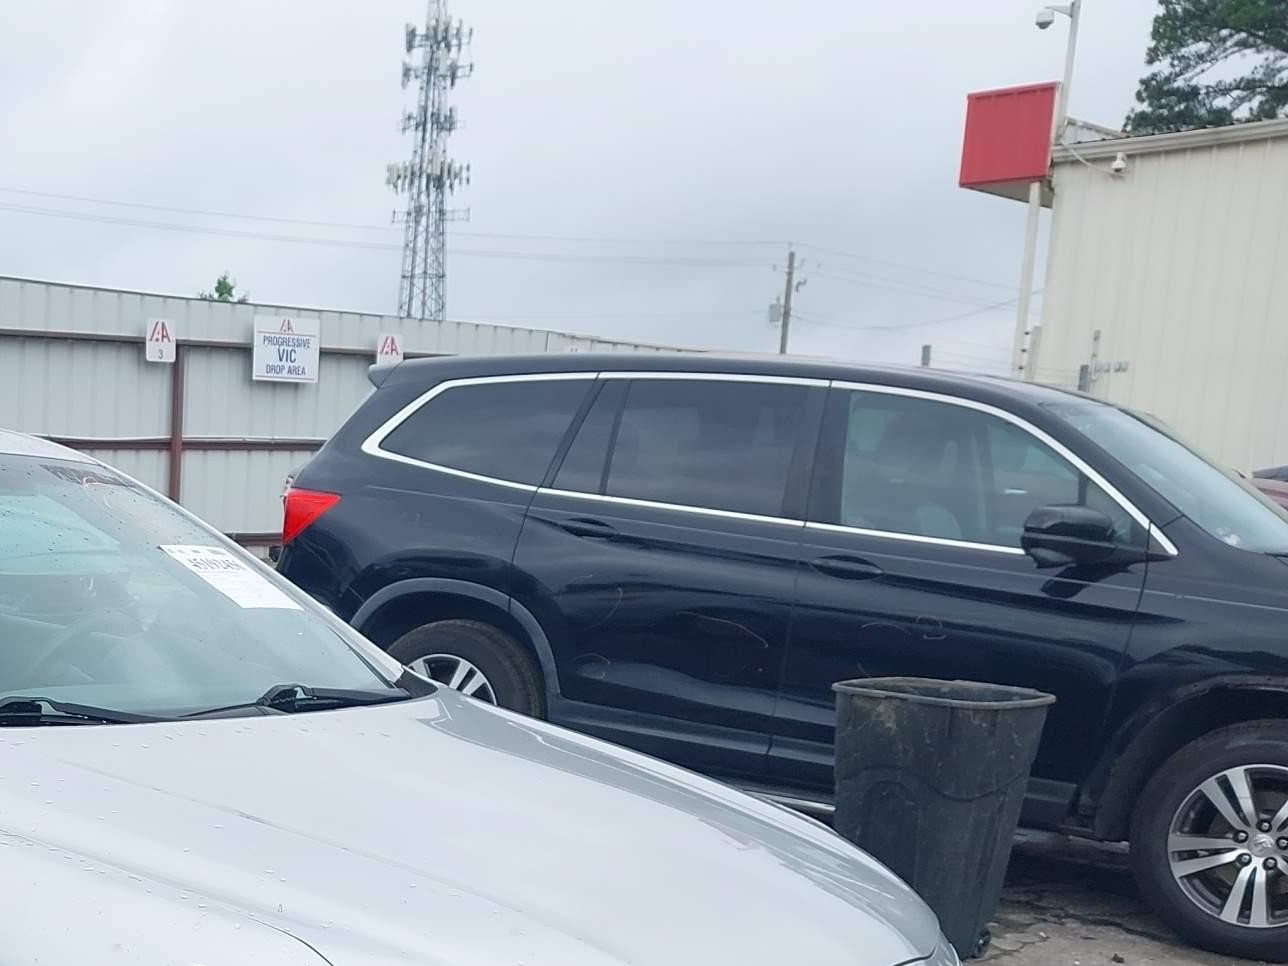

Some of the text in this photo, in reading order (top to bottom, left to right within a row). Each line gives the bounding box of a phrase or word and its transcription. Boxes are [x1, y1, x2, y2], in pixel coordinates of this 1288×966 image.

[263, 335, 312, 349] PROGRESSIVE
[158, 349, 164, 360] 3
[277, 348, 297, 364] VIC
[265, 364, 306, 376] DROP AREA
